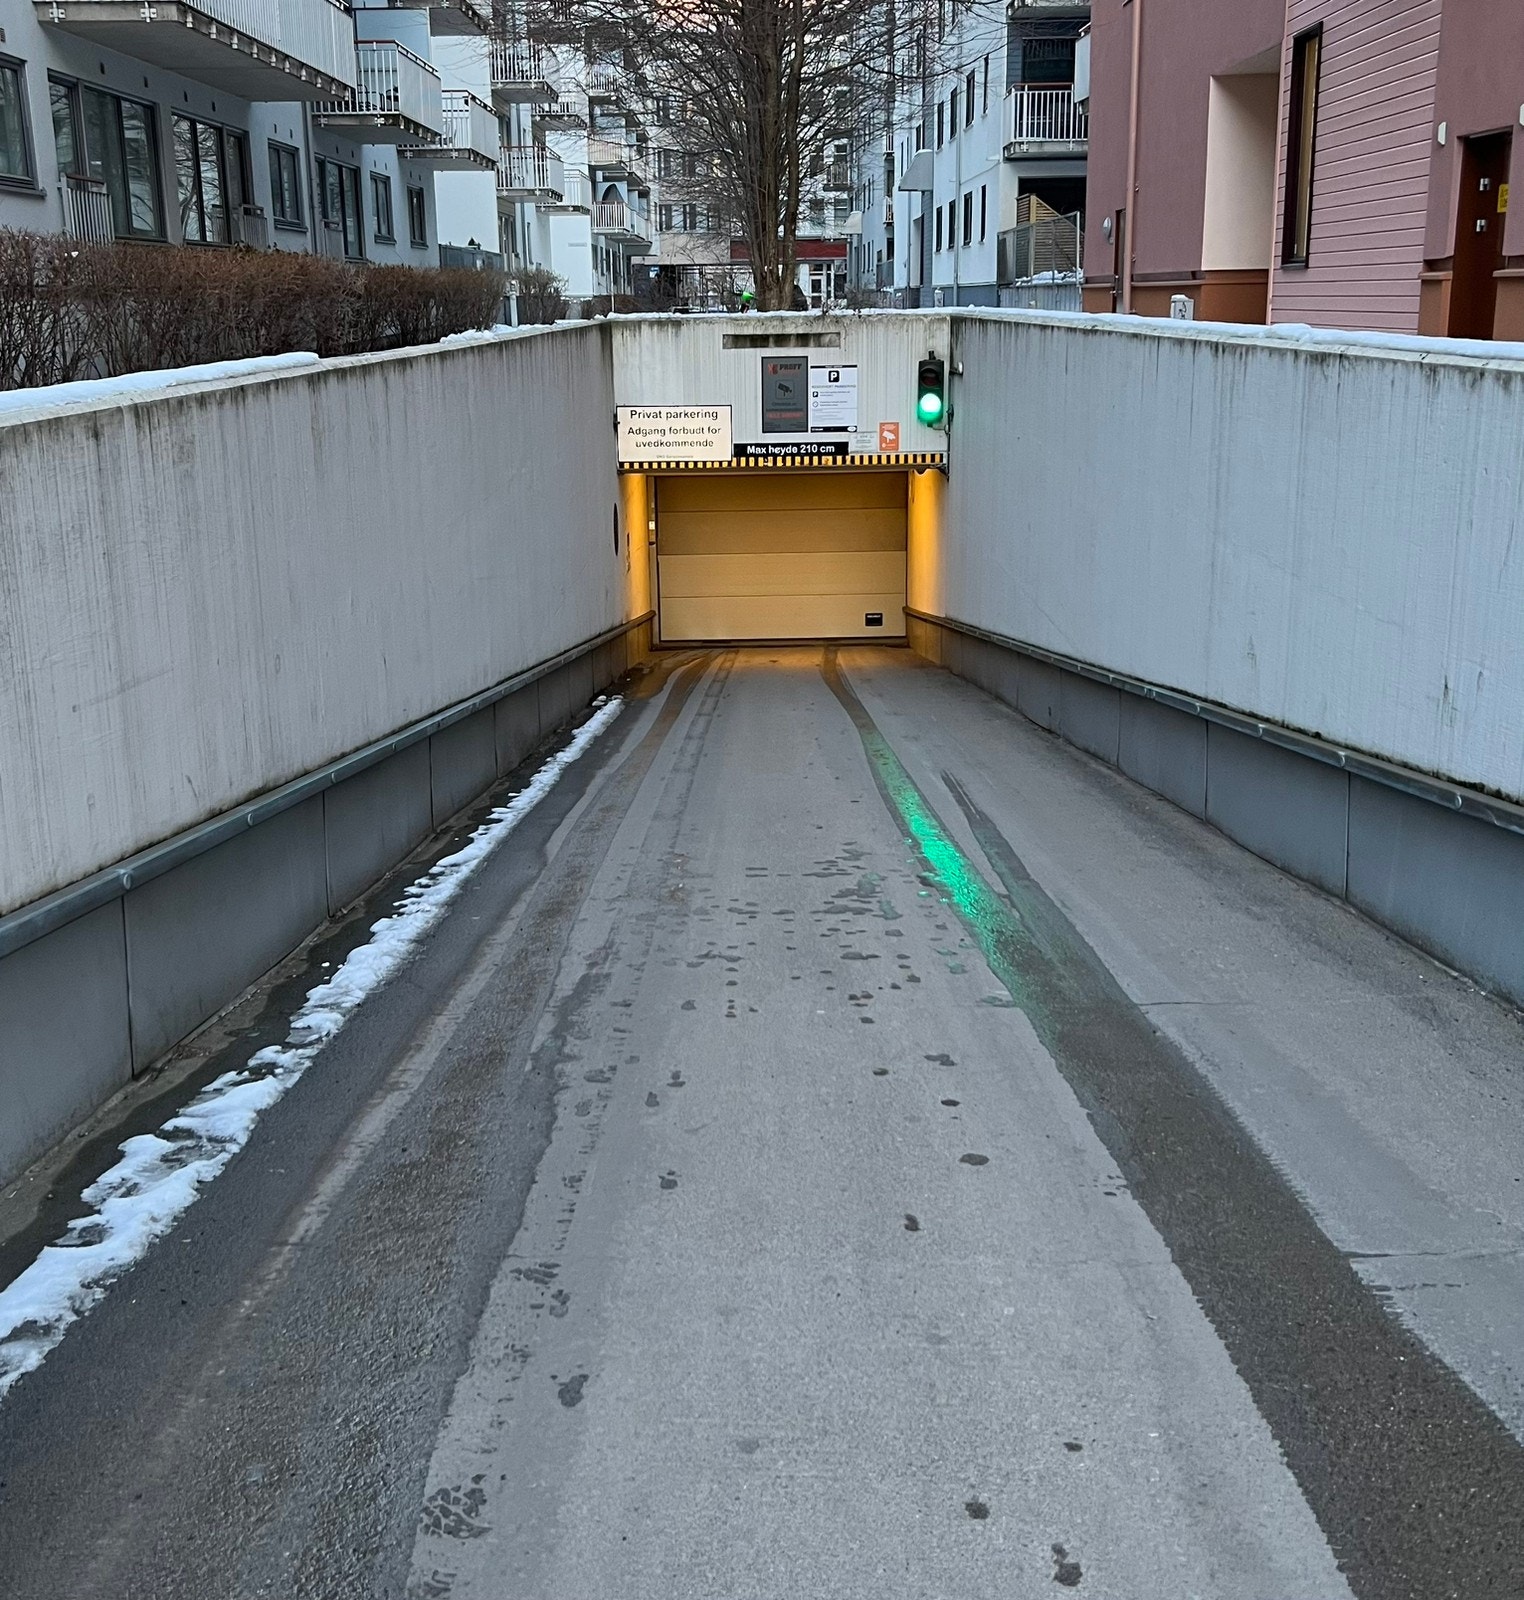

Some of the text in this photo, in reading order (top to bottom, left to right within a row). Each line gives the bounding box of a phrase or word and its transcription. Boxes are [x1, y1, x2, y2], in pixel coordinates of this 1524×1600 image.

[630, 409, 718, 421] Privat parkering
[627, 425, 721, 437] Adgang forbudt for
[635, 438, 714, 448] uvedkommende
[747, 444, 835, 456] Max høyde 210 cm
